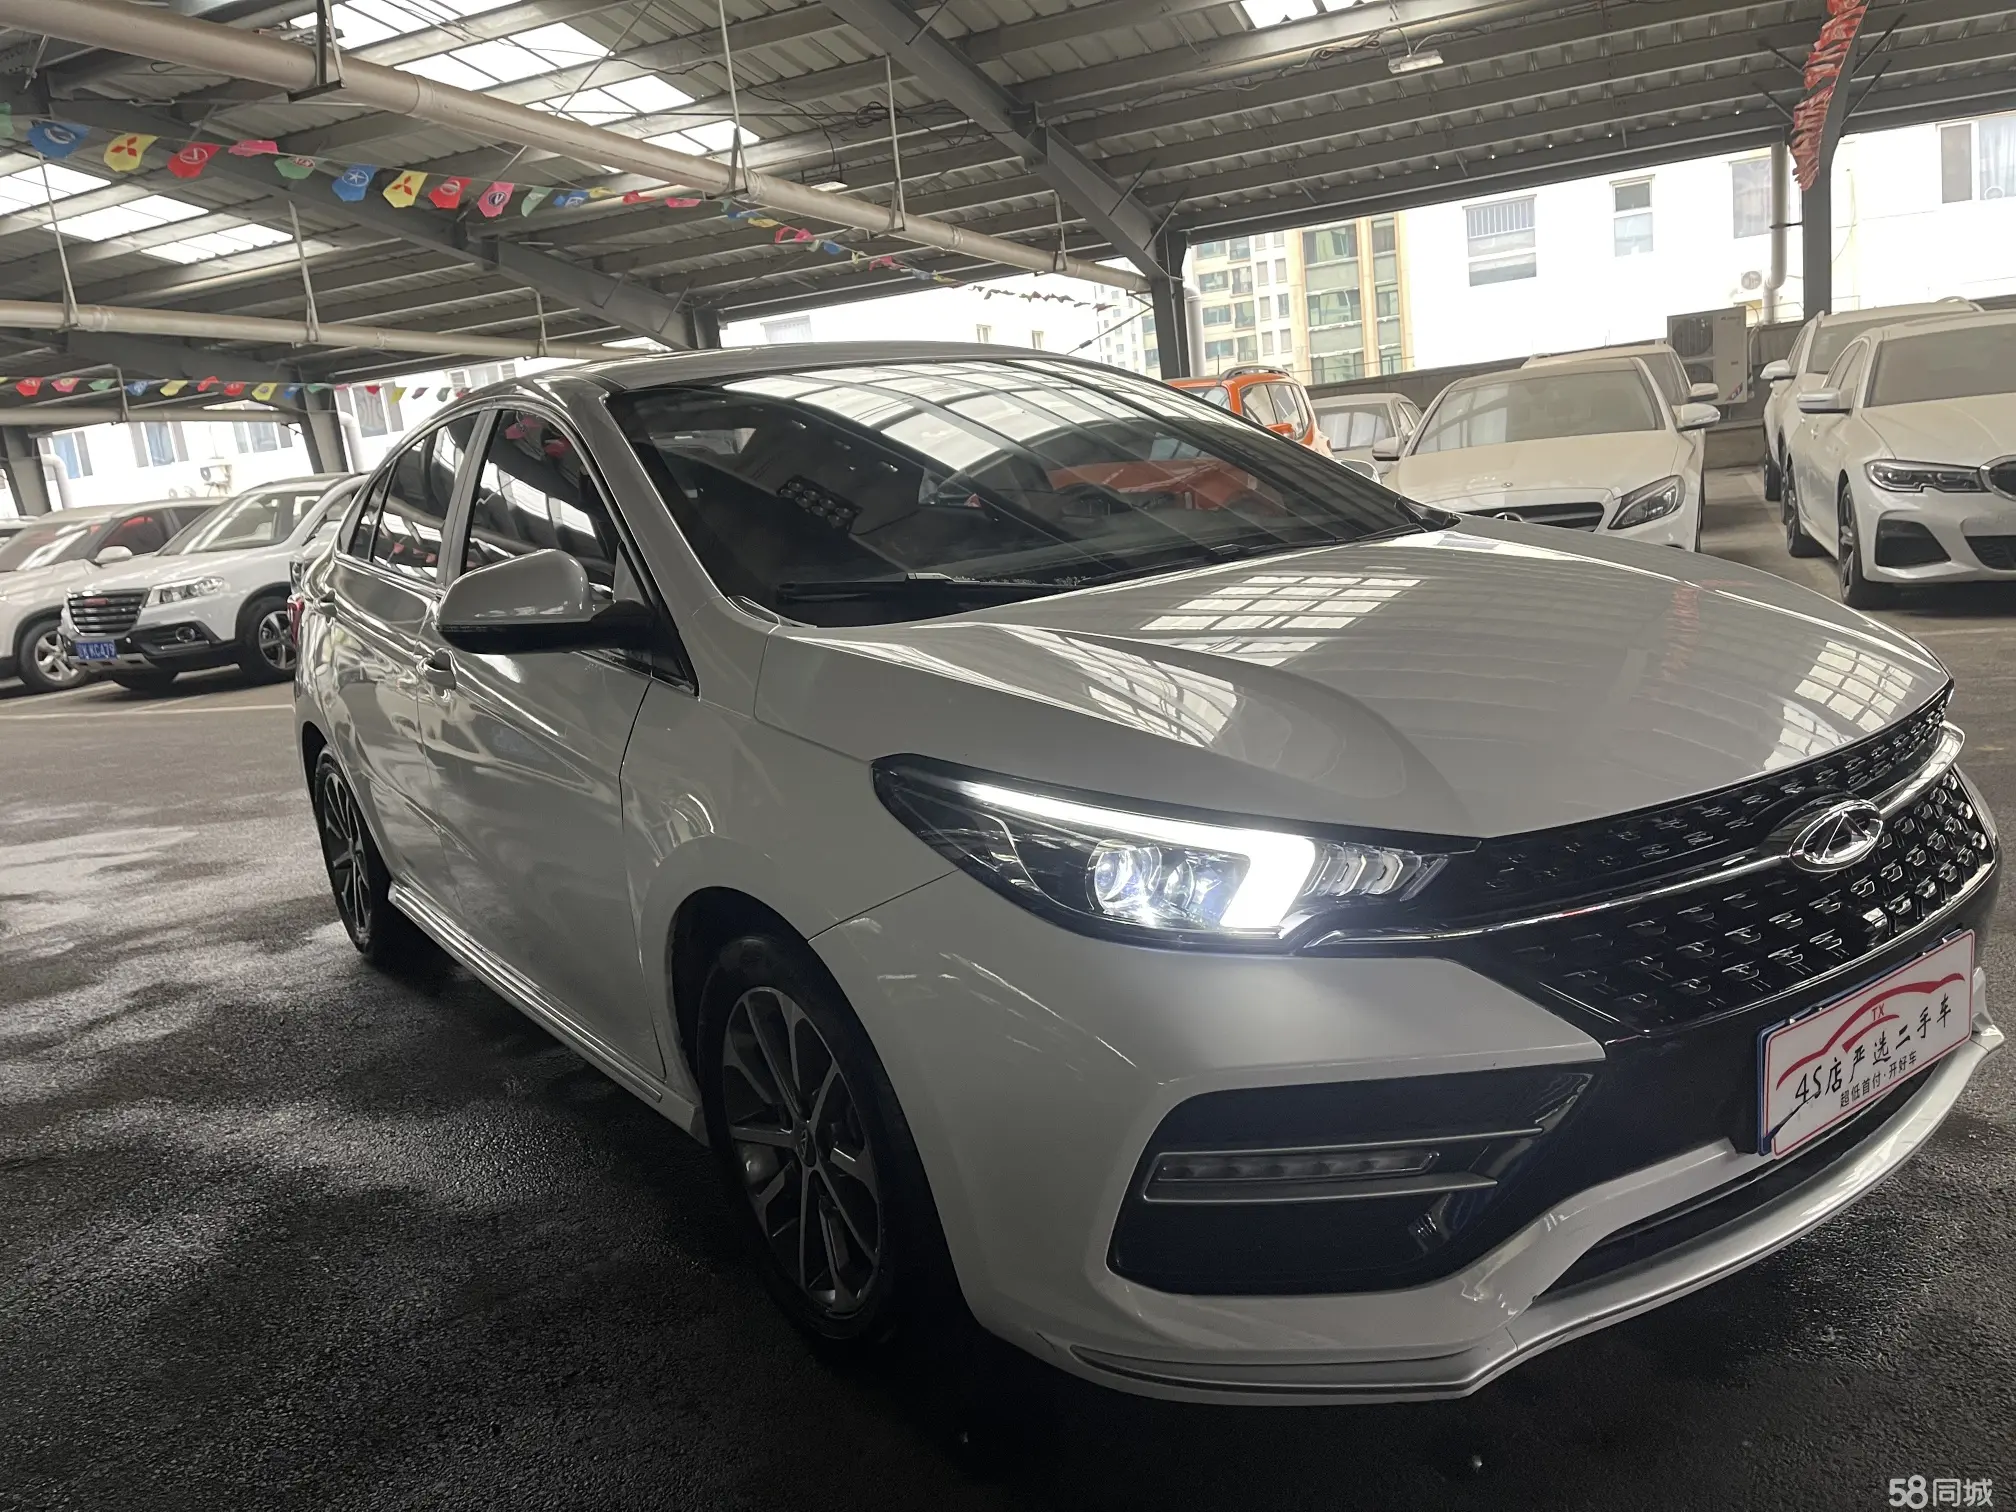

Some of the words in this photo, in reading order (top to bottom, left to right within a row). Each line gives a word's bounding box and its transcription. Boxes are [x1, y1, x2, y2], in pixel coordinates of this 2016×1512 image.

[1871, 1003, 1885, 1021] TX
[1795, 993, 1951, 1102] 4S店严选二手车
